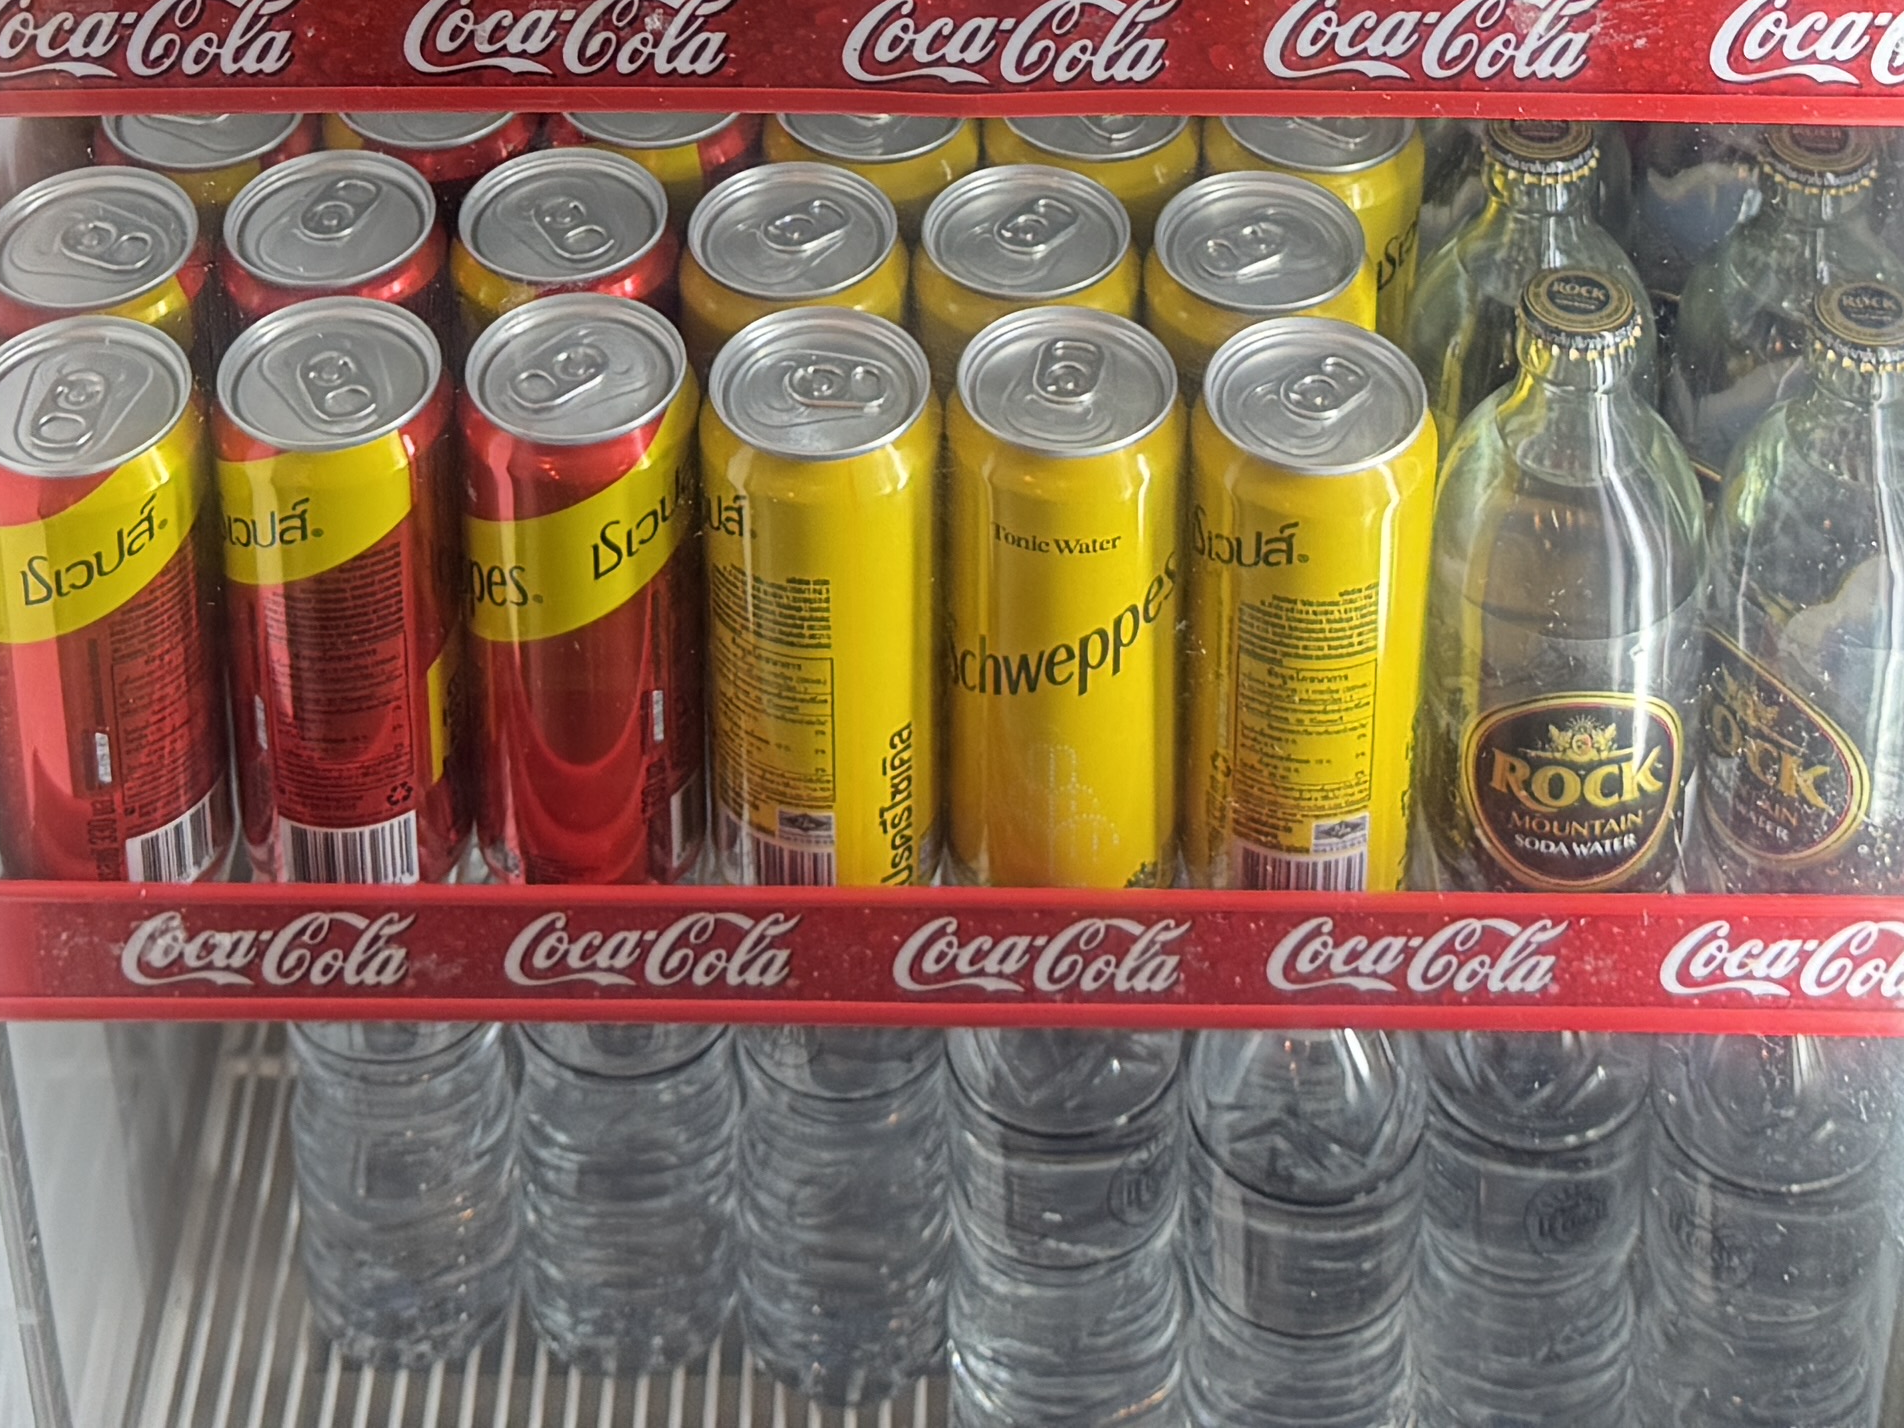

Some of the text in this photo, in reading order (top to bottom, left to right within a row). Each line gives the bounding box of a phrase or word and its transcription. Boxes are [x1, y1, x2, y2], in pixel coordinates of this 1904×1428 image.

[1550, 280, 1608, 301] ROCK
[20, 493, 157, 607] ชเวปส์
[992, 521, 1122, 555] Tonic Water
[1489, 745, 1664, 813] ROCK
[1712, 704, 1836, 817] OCK
[1509, 809, 1643, 838] MOUNTAIN
[1514, 832, 1638, 859] SODA WATER
[122, 910, 408, 989] Coca-Cola
[503, 912, 799, 987] Coca-Cola
[892, 916, 1188, 997] Coca-Cola
[1266, 916, 1572, 1000] Coca-Cola
